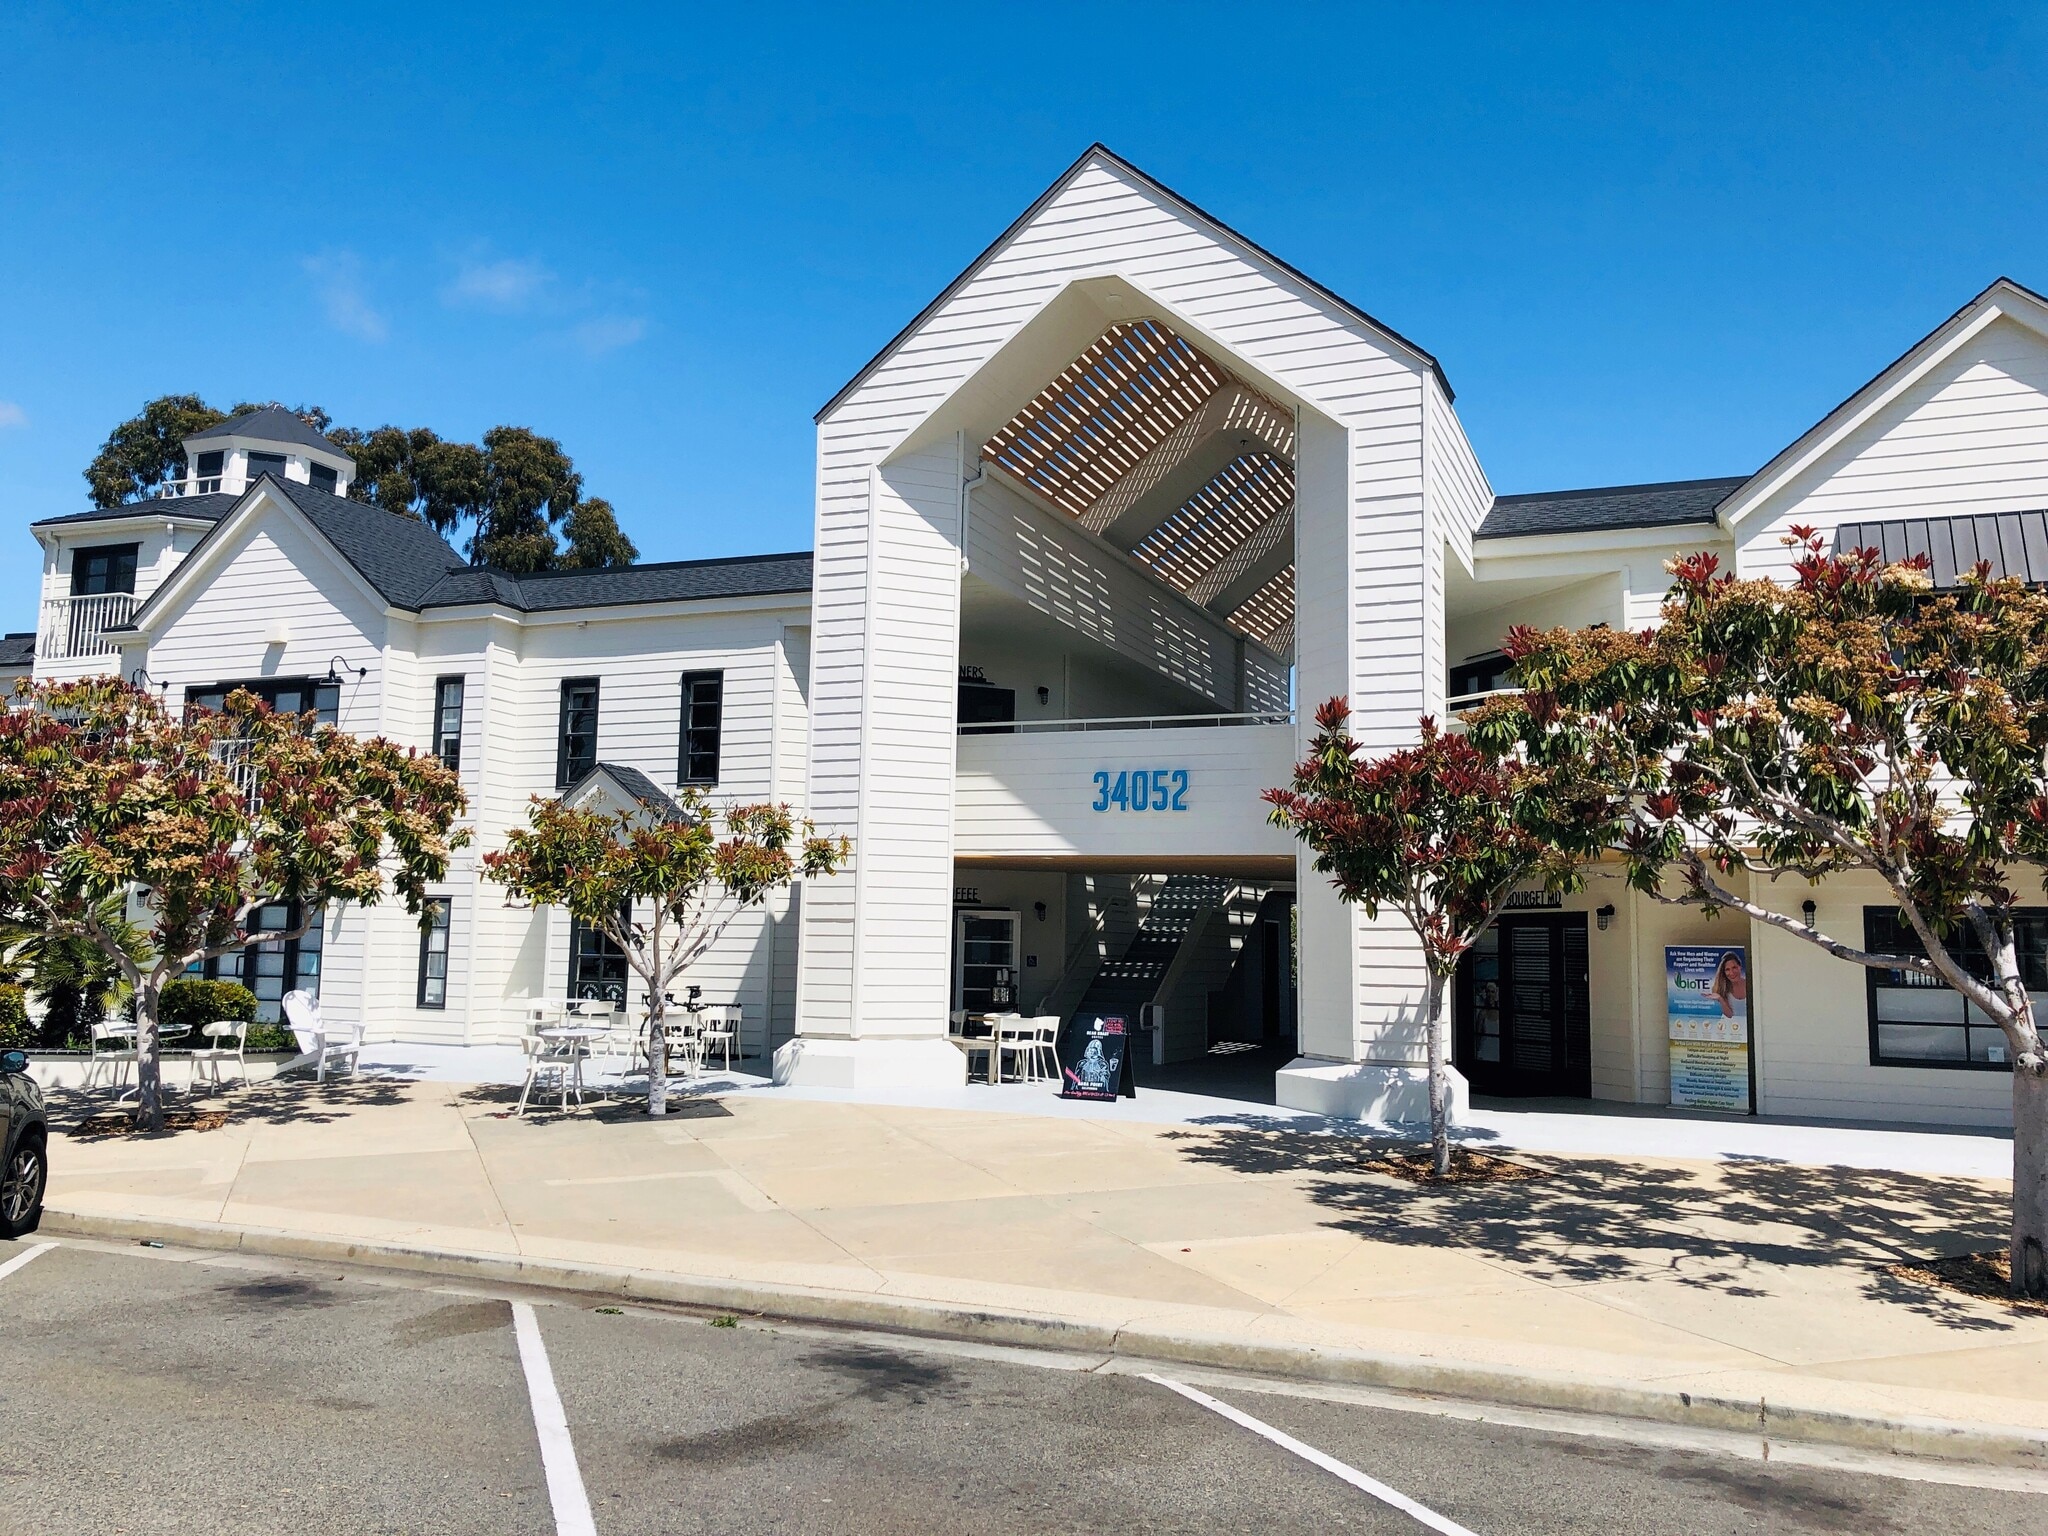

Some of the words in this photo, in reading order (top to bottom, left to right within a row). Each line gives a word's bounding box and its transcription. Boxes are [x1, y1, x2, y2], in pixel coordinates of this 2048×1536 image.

[1092, 769, 1189, 812] 34052
[1507, 890, 1545, 906] BOURGET
[1547, 890, 1561, 905] MD
[1677, 975, 1710, 990] bioTE
